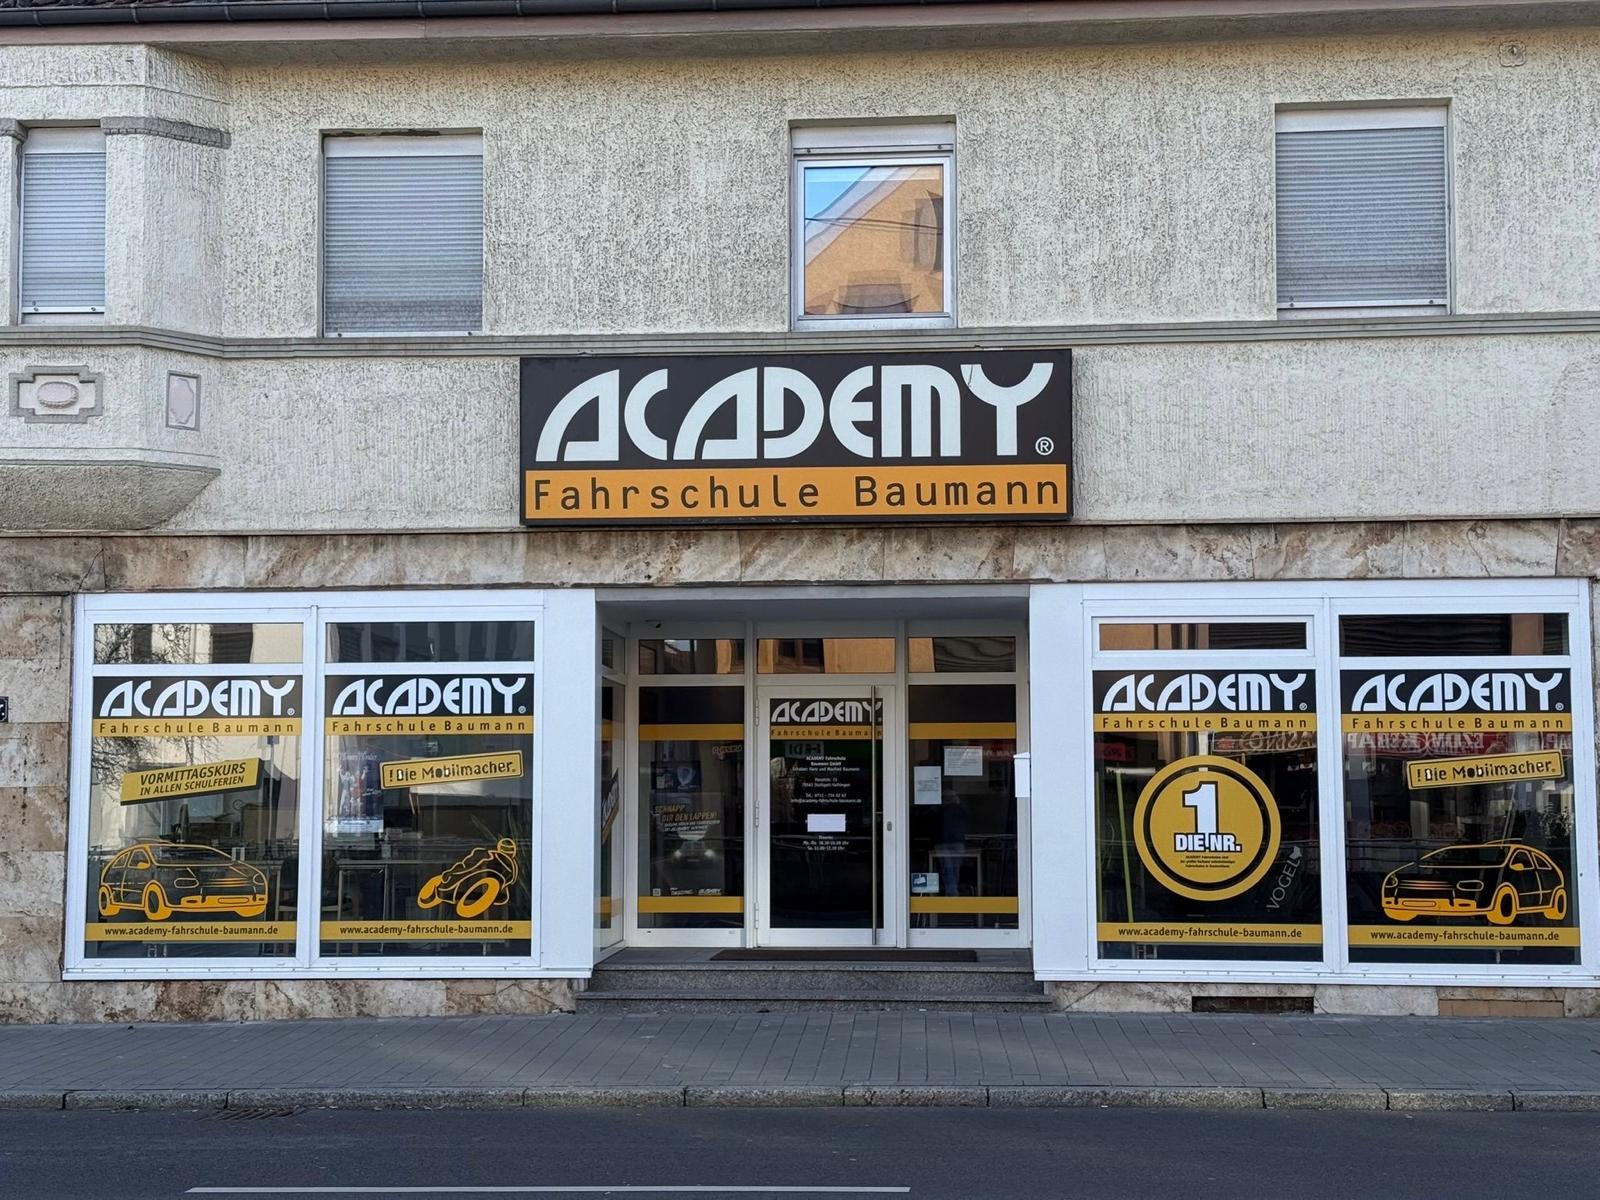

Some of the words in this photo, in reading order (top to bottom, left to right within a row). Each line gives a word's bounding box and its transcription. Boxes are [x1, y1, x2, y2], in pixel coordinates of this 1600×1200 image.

[535, 362, 1054, 462] ACADEMY
[534, 474, 819, 511] Fahrschule
[855, 475, 1059, 509] Baumann
[99, 679, 296, 717] ACADEMY
[332, 677, 527, 716] ACADEMY
[1101, 673, 1307, 712] ACADEMY
[1351, 673, 1563, 712] ACADEMY
[99, 722, 204, 734] Fahrschule
[212, 721, 294, 734] Baumann
[332, 721, 436, 733] Fahrschule
[444, 720, 526, 732] Baumann
[1102, 717, 1212, 729] Fahrschule
[1220, 717, 1307, 729] Baumann
[1352, 717, 1466, 730] Fahrschule
[1474, 717, 1564, 729] Baumann
[771, 729, 831, 737] Fahrschule
[835, 729, 882, 737] Bauman
[139, 762, 247, 786] VORMITTAGSKURS
[140, 786, 151, 796] IN
[153, 783, 182, 795] ALLEN
[184, 775, 245, 791] SCHULFERIEN
[1265, 860, 1301, 909] VOGEL
[104, 924, 278, 937] www.academy-fahrschule-baumann.de
[339, 924, 514, 937] www.academy-fahrschule-baumann.de
[1118, 927, 1302, 939] www.academy-fahrschule-baumann.de
[1370, 930, 1560, 942] www.academy-fahrschule-baumann.de
